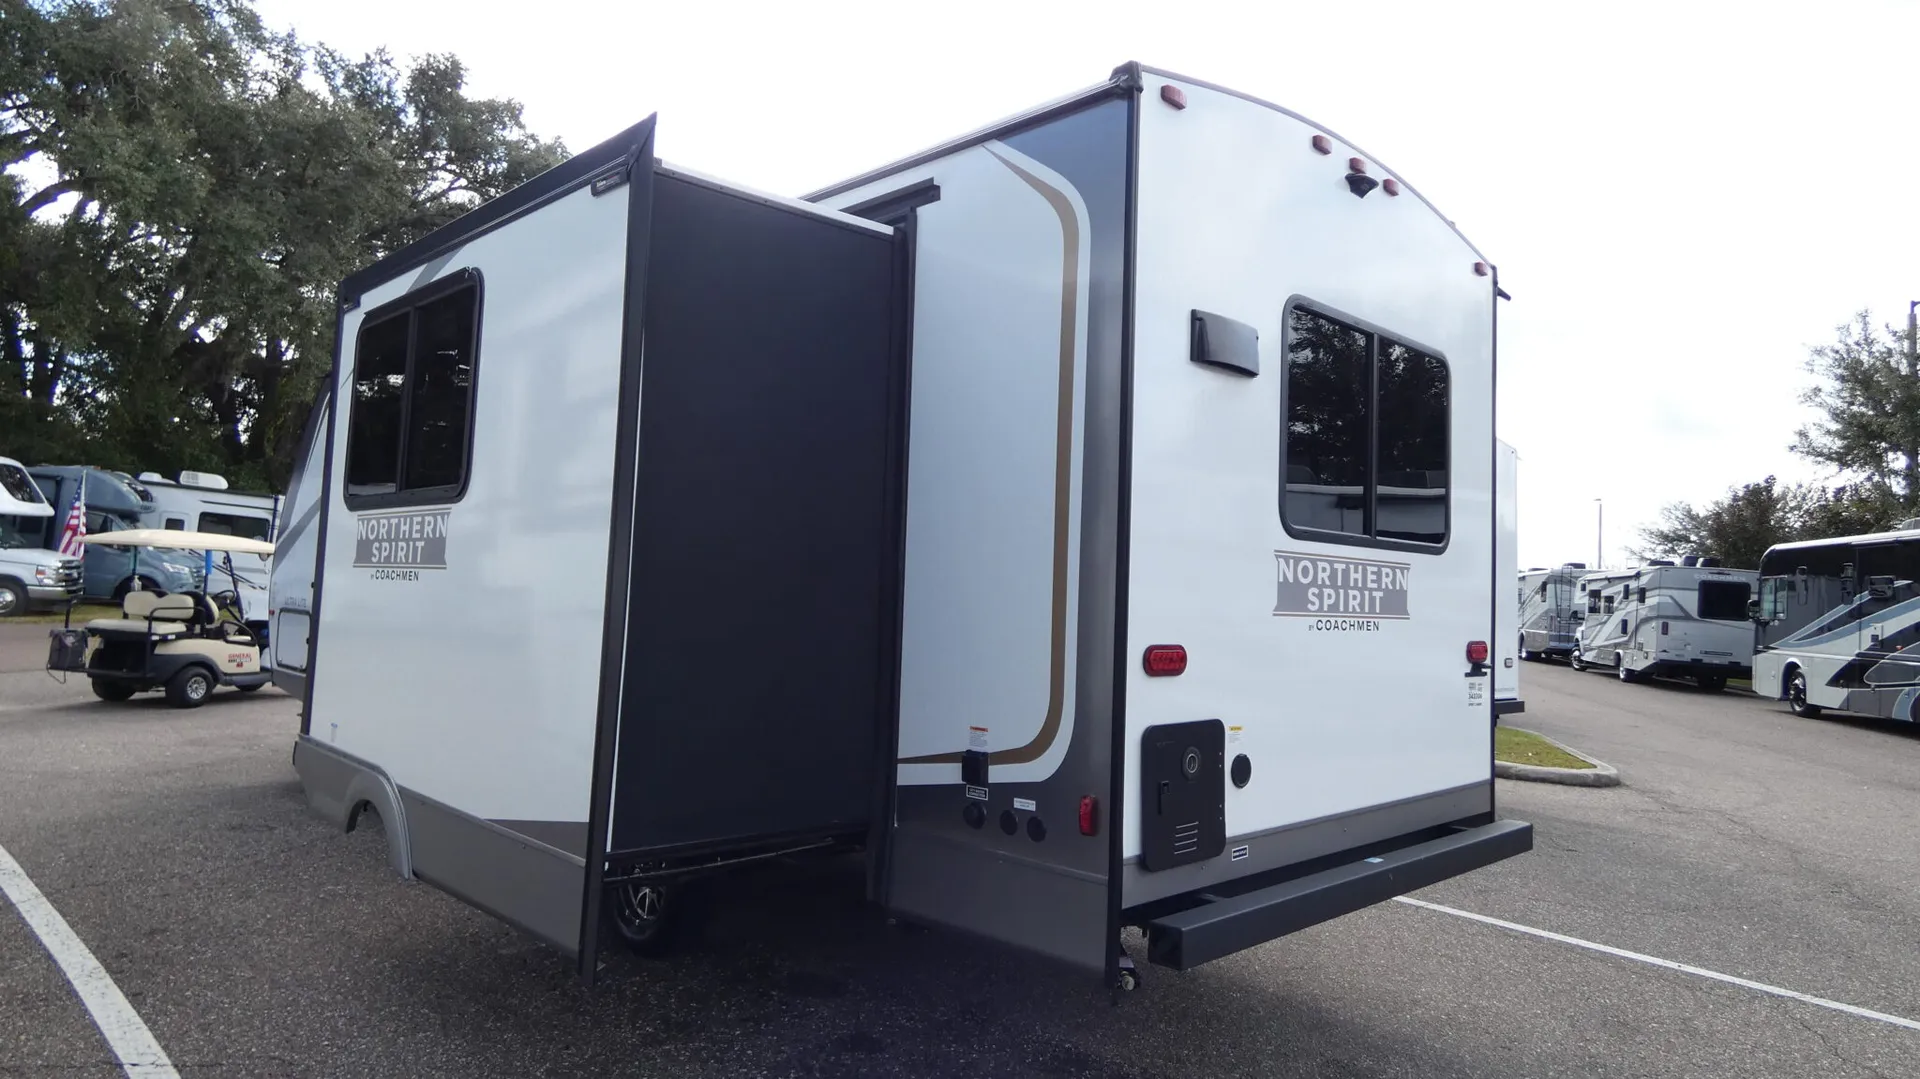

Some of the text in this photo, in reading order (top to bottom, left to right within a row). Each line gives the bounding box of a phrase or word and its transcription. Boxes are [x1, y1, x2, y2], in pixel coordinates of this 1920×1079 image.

[358, 514, 448, 541] NORTHERN
[371, 541, 425, 563] SPIRIT
[375, 569, 420, 581] COACHMEN
[1278, 558, 1408, 591] NORTHERN
[1307, 587, 1384, 613] SPIRIT
[1315, 619, 1380, 632] COACHMEN
